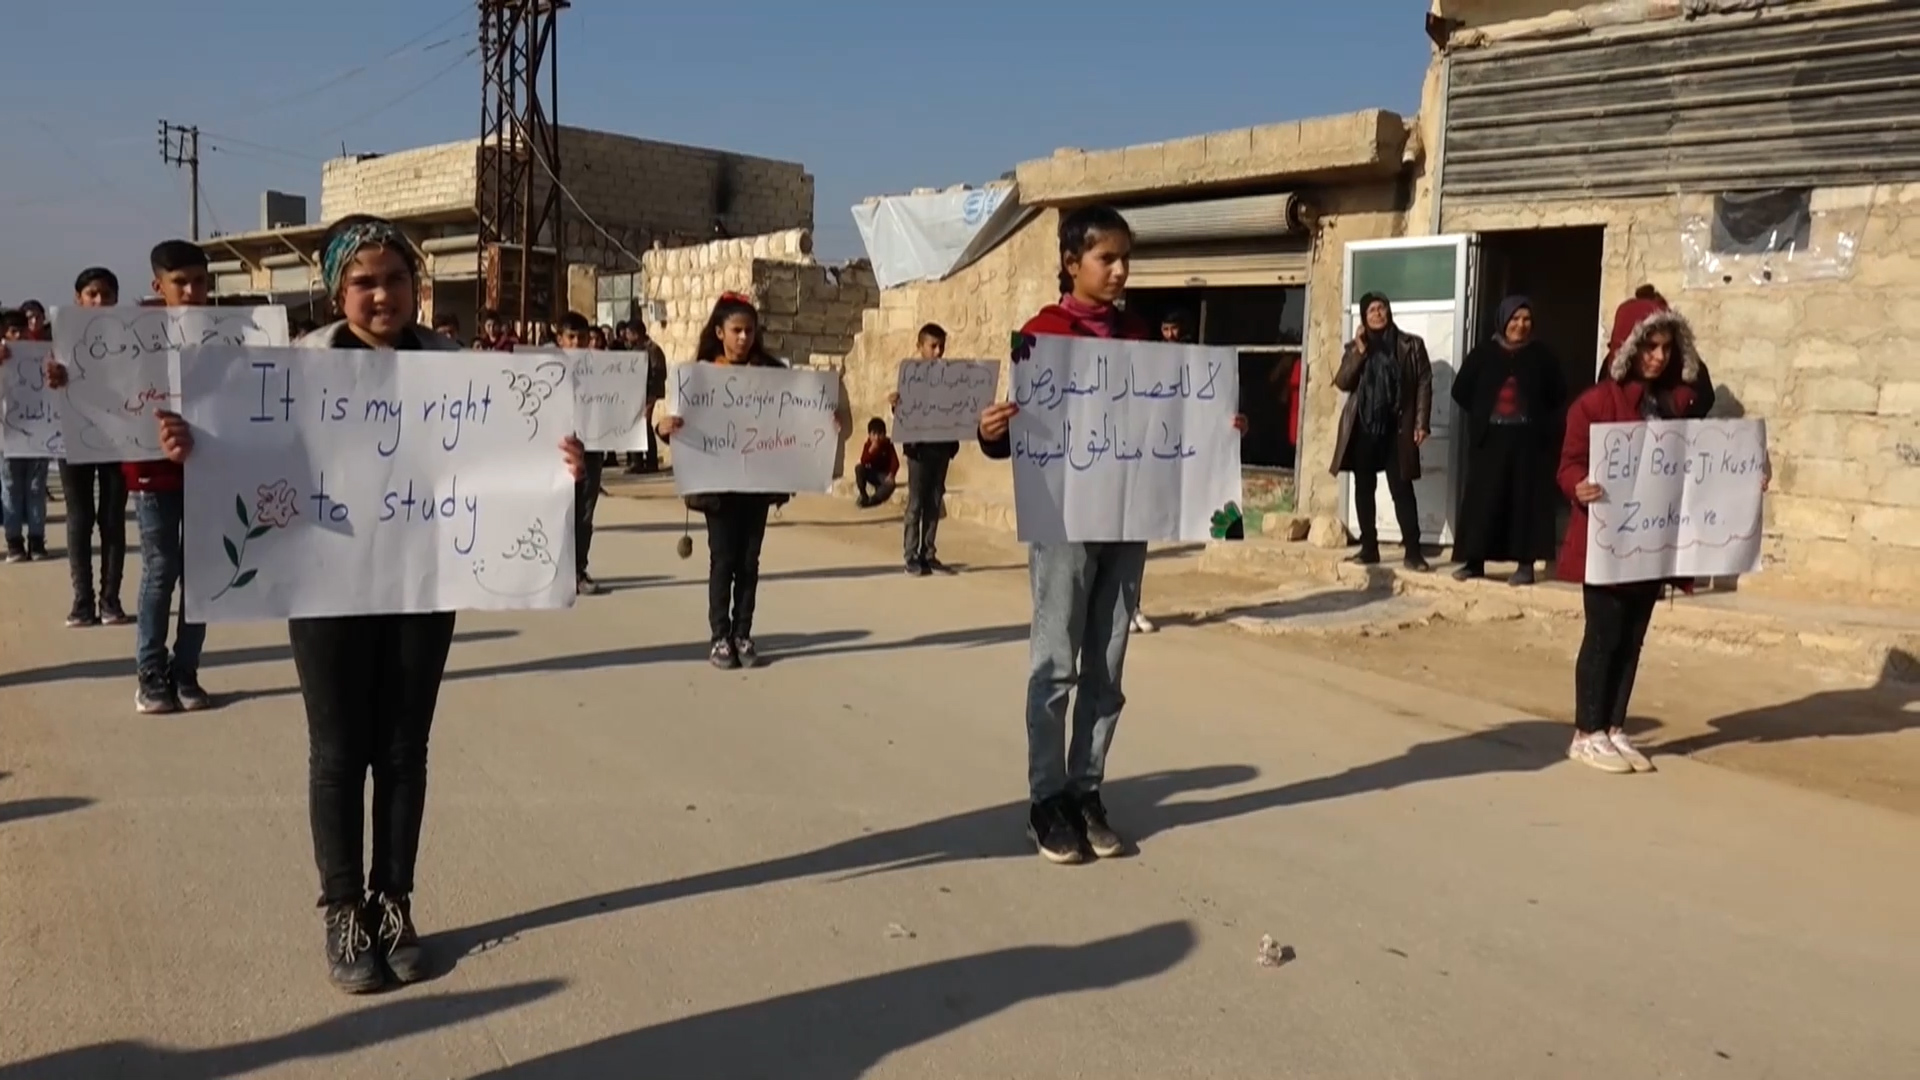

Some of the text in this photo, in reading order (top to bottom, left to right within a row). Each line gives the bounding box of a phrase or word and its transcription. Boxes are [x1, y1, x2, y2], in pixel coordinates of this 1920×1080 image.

[250, 362, 492, 458] It is my right
[1015, 354, 1222, 410] لا للحصار المفروض
[1015, 412, 1197, 472] على مناطق الشهباء
[309, 470, 478, 555] to study
